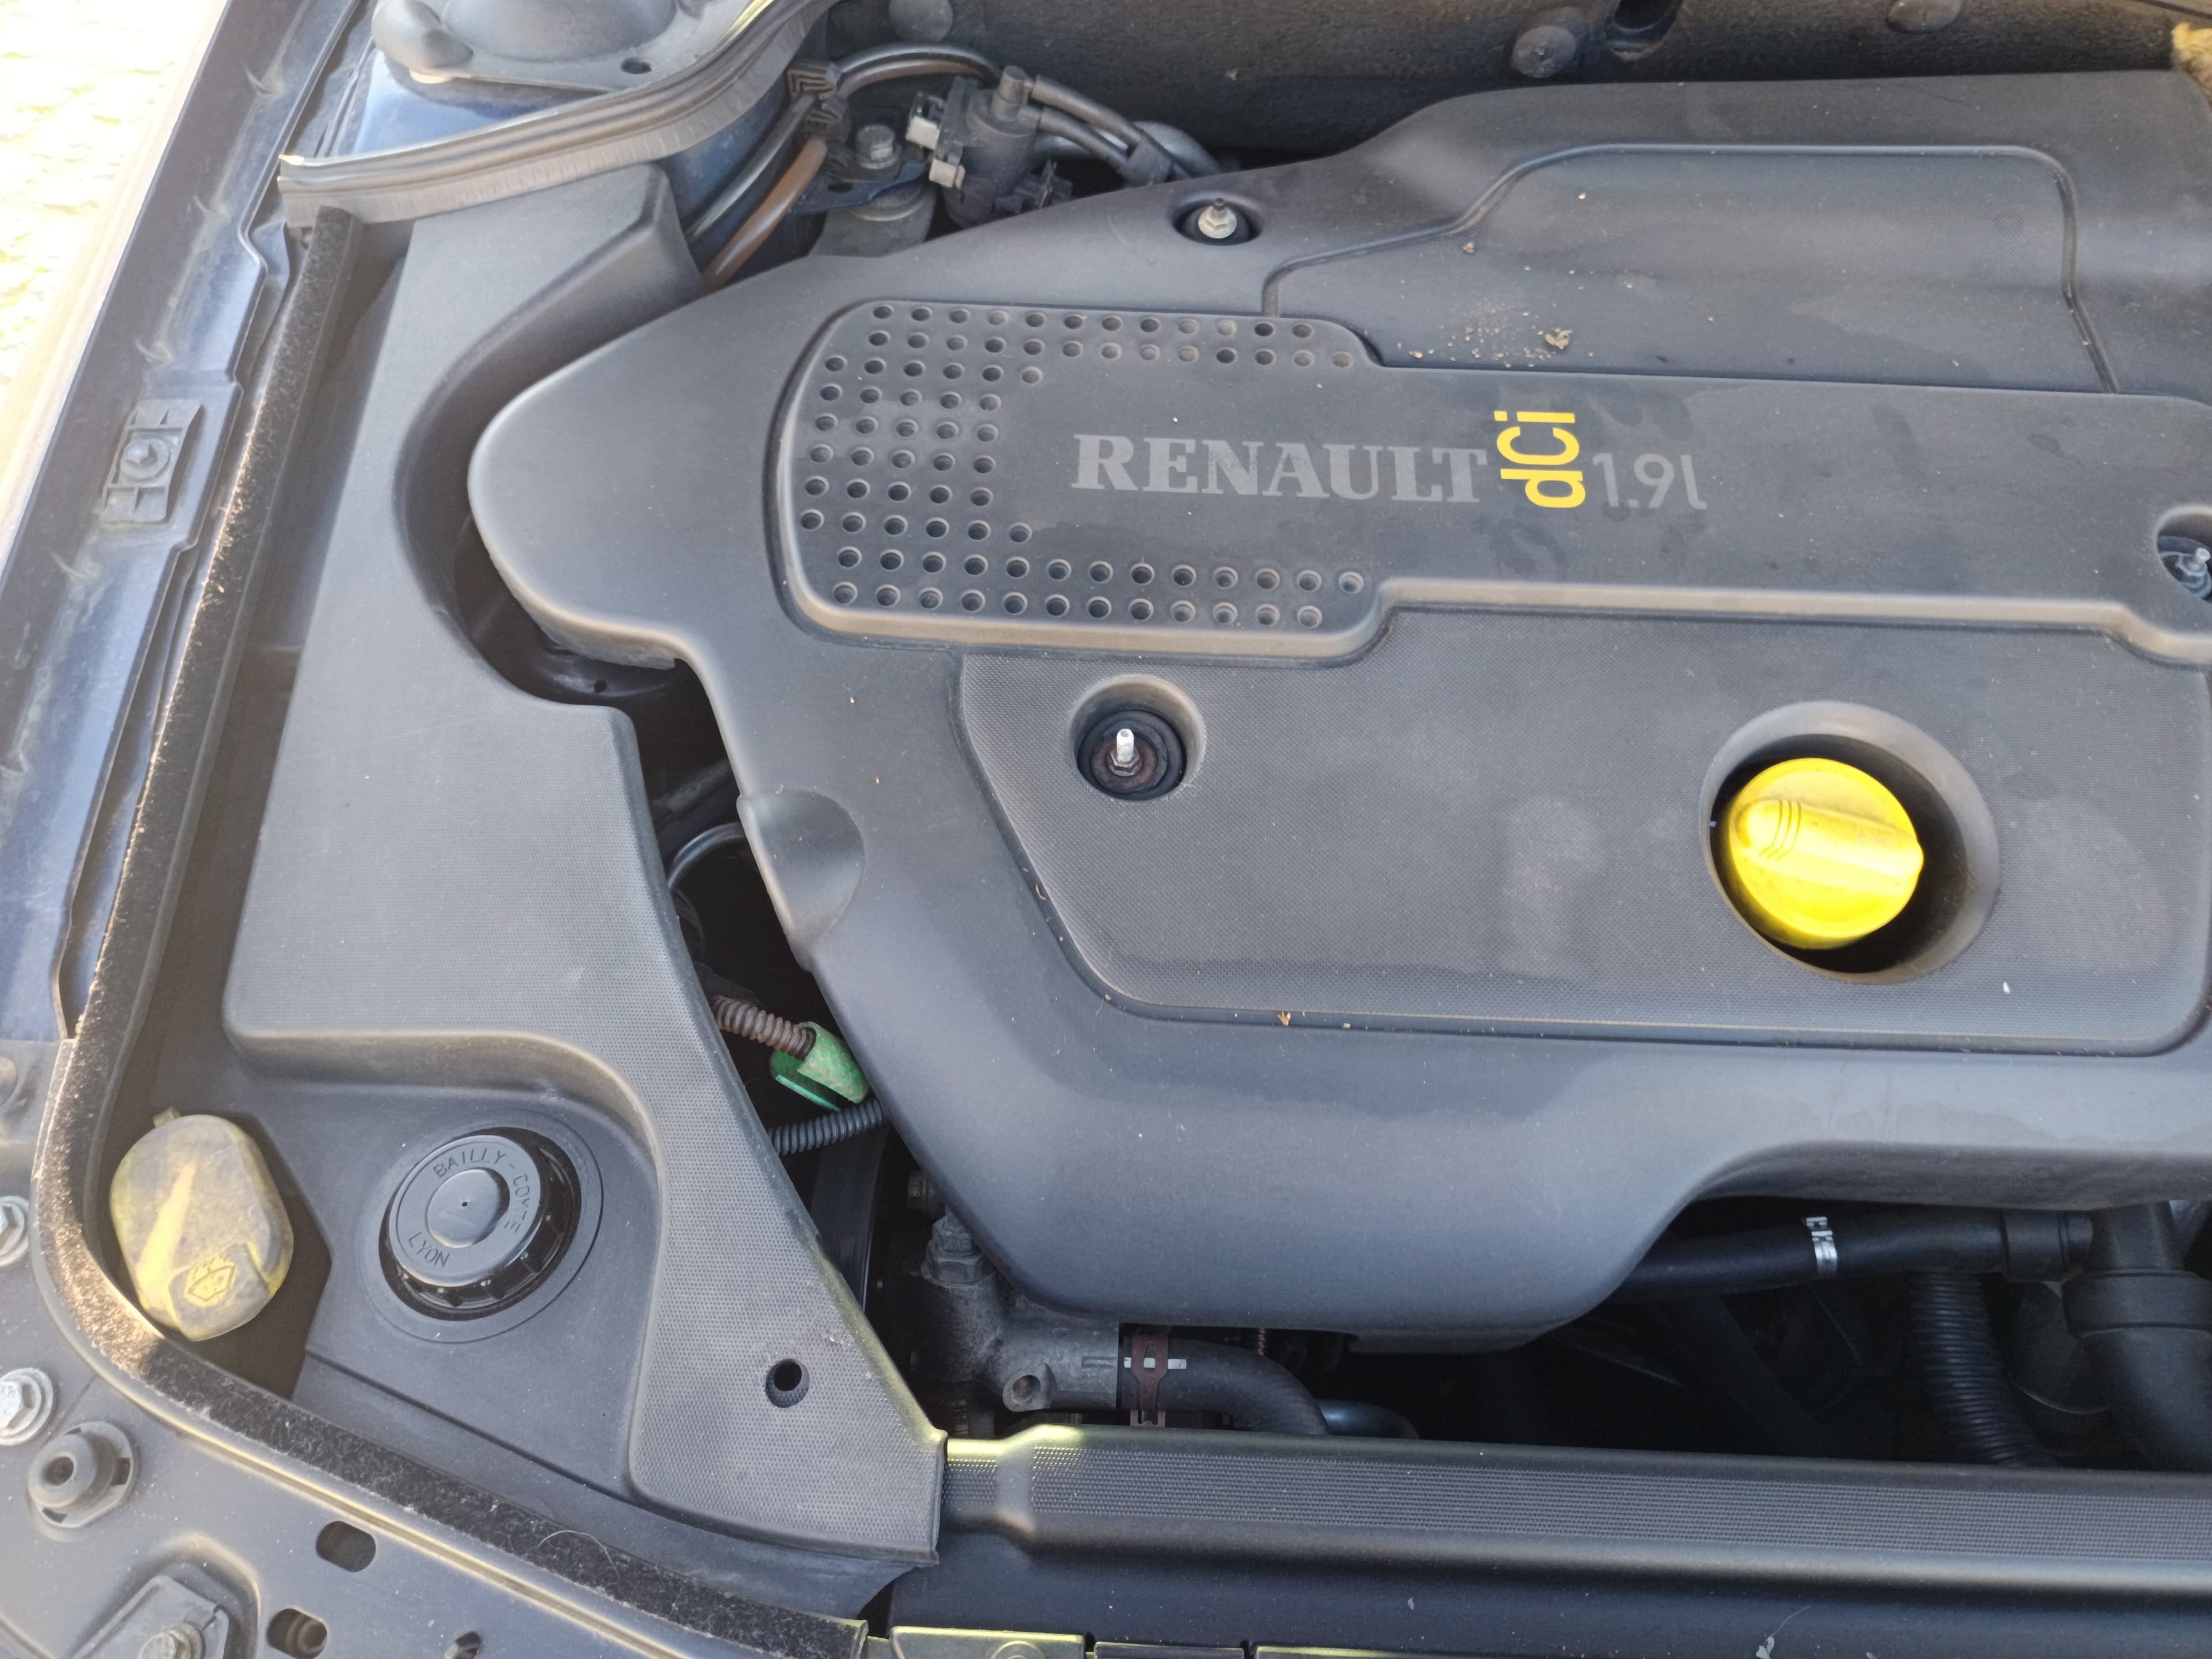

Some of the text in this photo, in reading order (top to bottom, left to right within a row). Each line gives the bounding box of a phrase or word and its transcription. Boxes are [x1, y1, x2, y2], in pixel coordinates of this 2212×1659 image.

[1071, 434, 1487, 503] RENAULT
[1494, 410, 1586, 508] dCi
[407, 1232, 450, 1267] LYON
